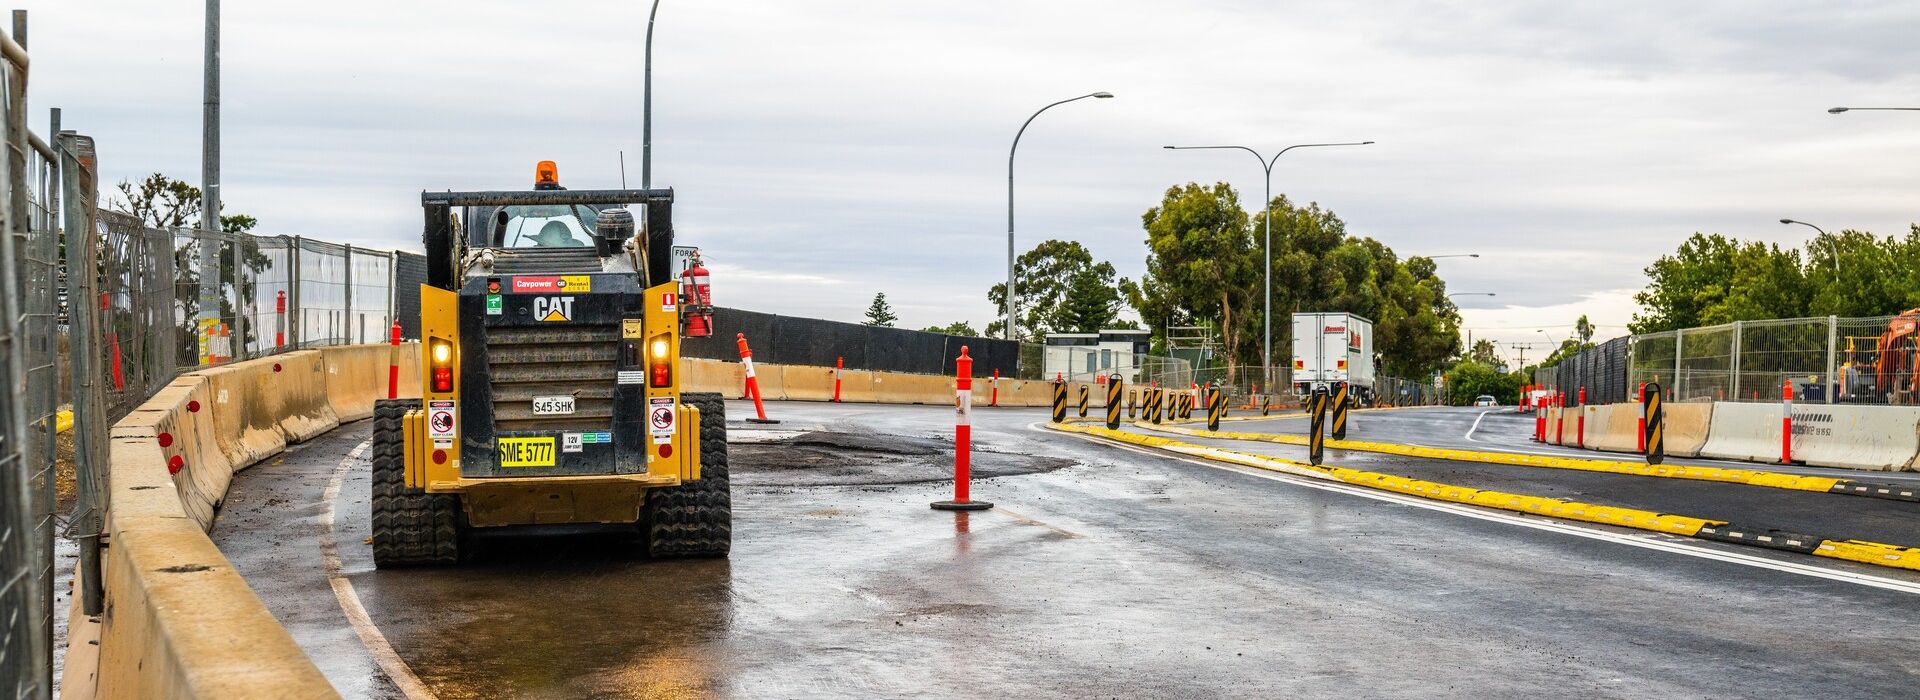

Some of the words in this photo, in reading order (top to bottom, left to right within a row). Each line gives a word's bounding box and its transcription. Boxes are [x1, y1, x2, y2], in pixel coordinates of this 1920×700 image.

[682, 259, 687, 271] 1
[516, 280, 553, 289] Cavpower
[534, 296, 575, 322] CAT
[568, 436, 578, 444] 12V
[499, 442, 523, 462] SME
[526, 442, 553, 462] 5777
